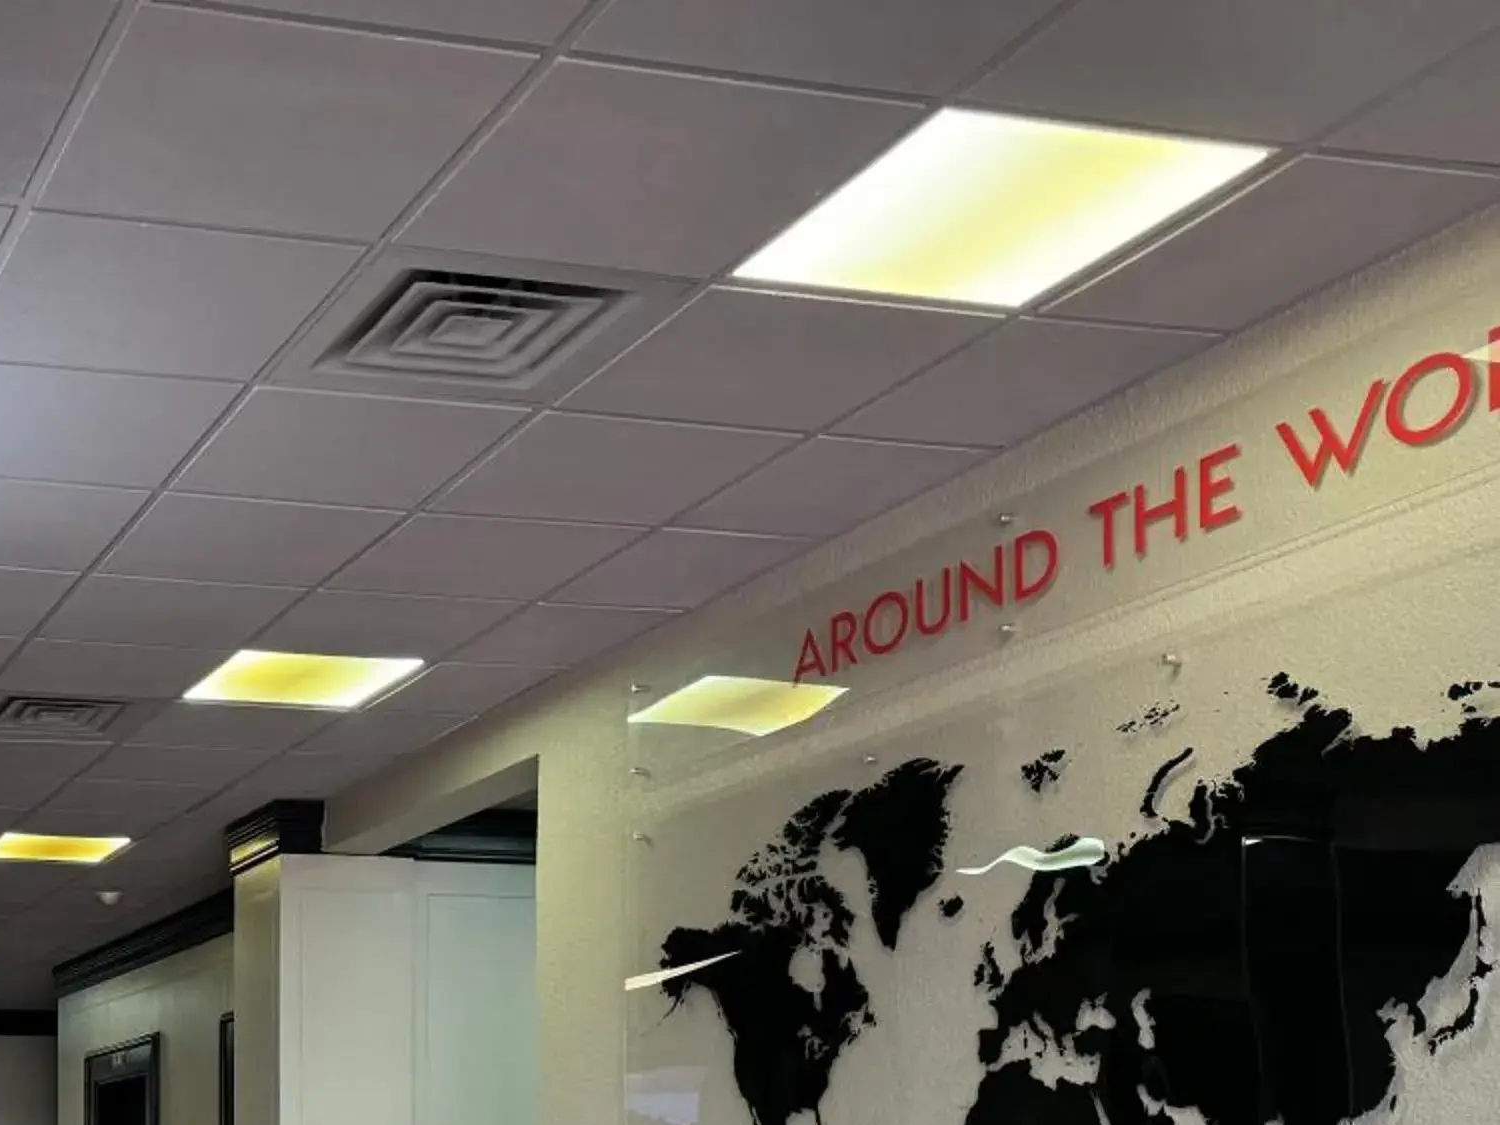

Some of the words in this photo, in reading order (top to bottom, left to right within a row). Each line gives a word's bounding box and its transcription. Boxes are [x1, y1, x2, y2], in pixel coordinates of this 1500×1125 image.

[792, 529, 1059, 687] AROUND
[1087, 442, 1242, 571] THE
[1274, 326, 1500, 487] WO
